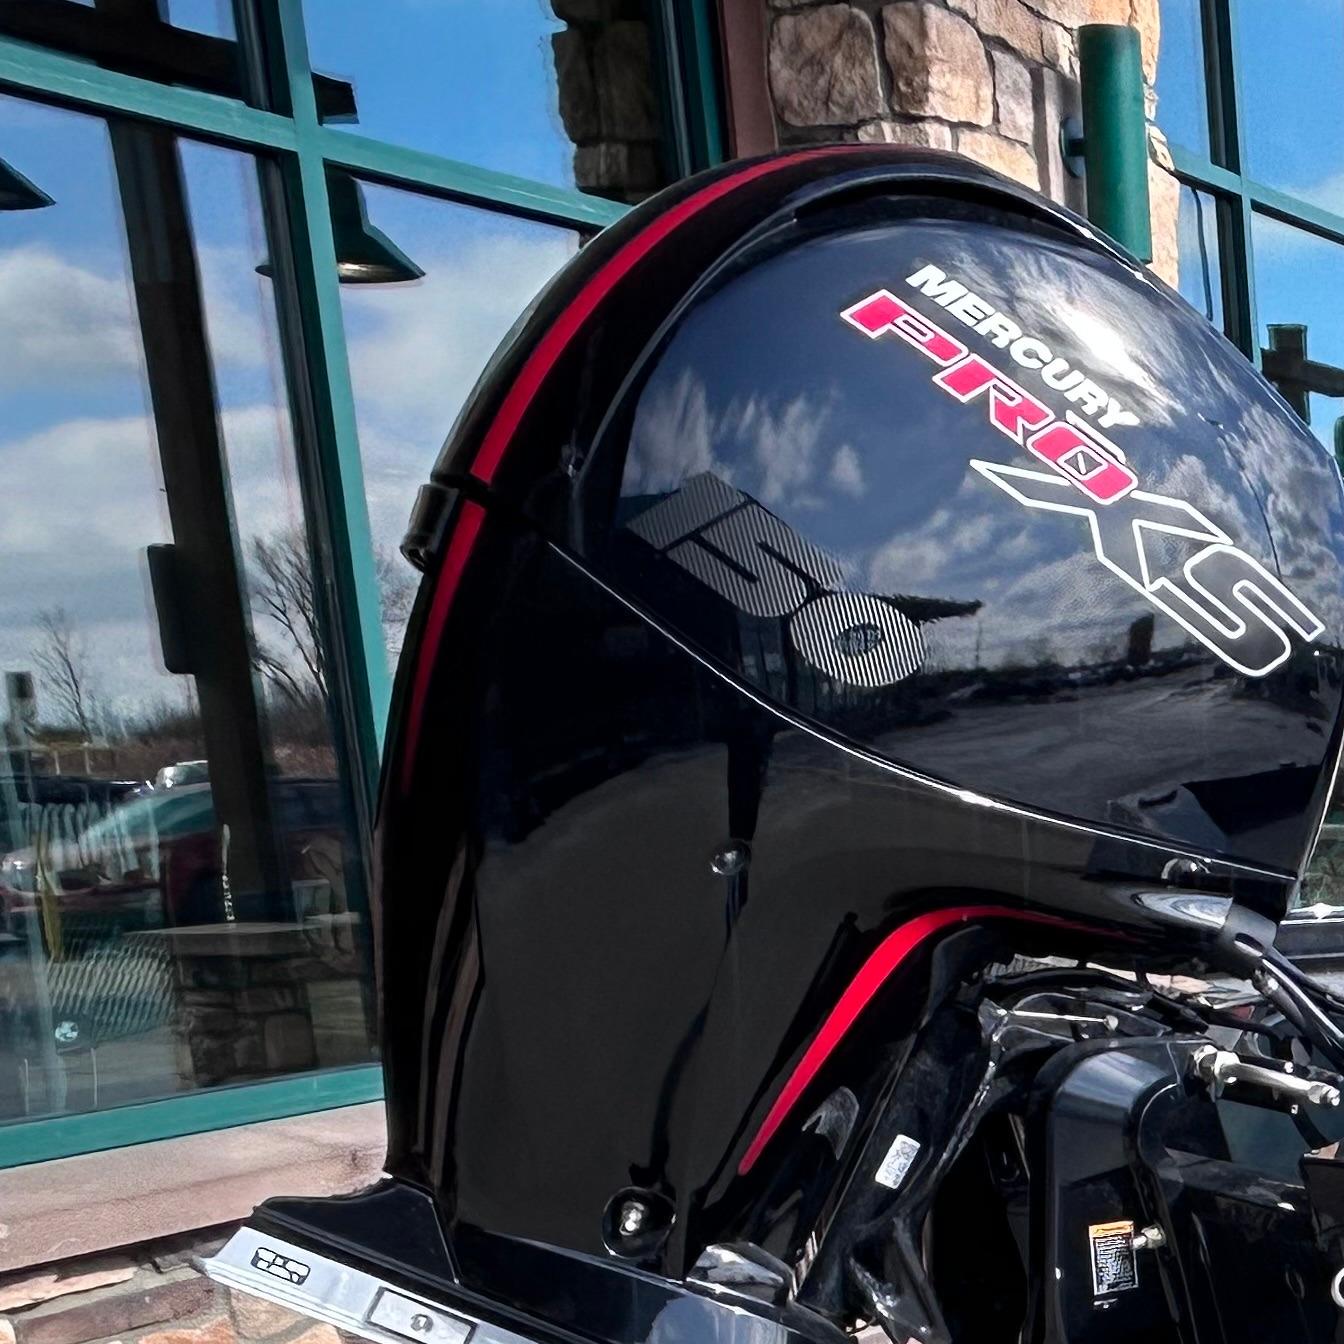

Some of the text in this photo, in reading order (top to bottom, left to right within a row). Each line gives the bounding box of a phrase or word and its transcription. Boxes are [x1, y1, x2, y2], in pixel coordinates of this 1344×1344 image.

[840, 288, 1139, 505] PRO
[905, 263, 1140, 430] MERCURY
[625, 469, 928, 688] 150
[969, 410, 1326, 677] XS
